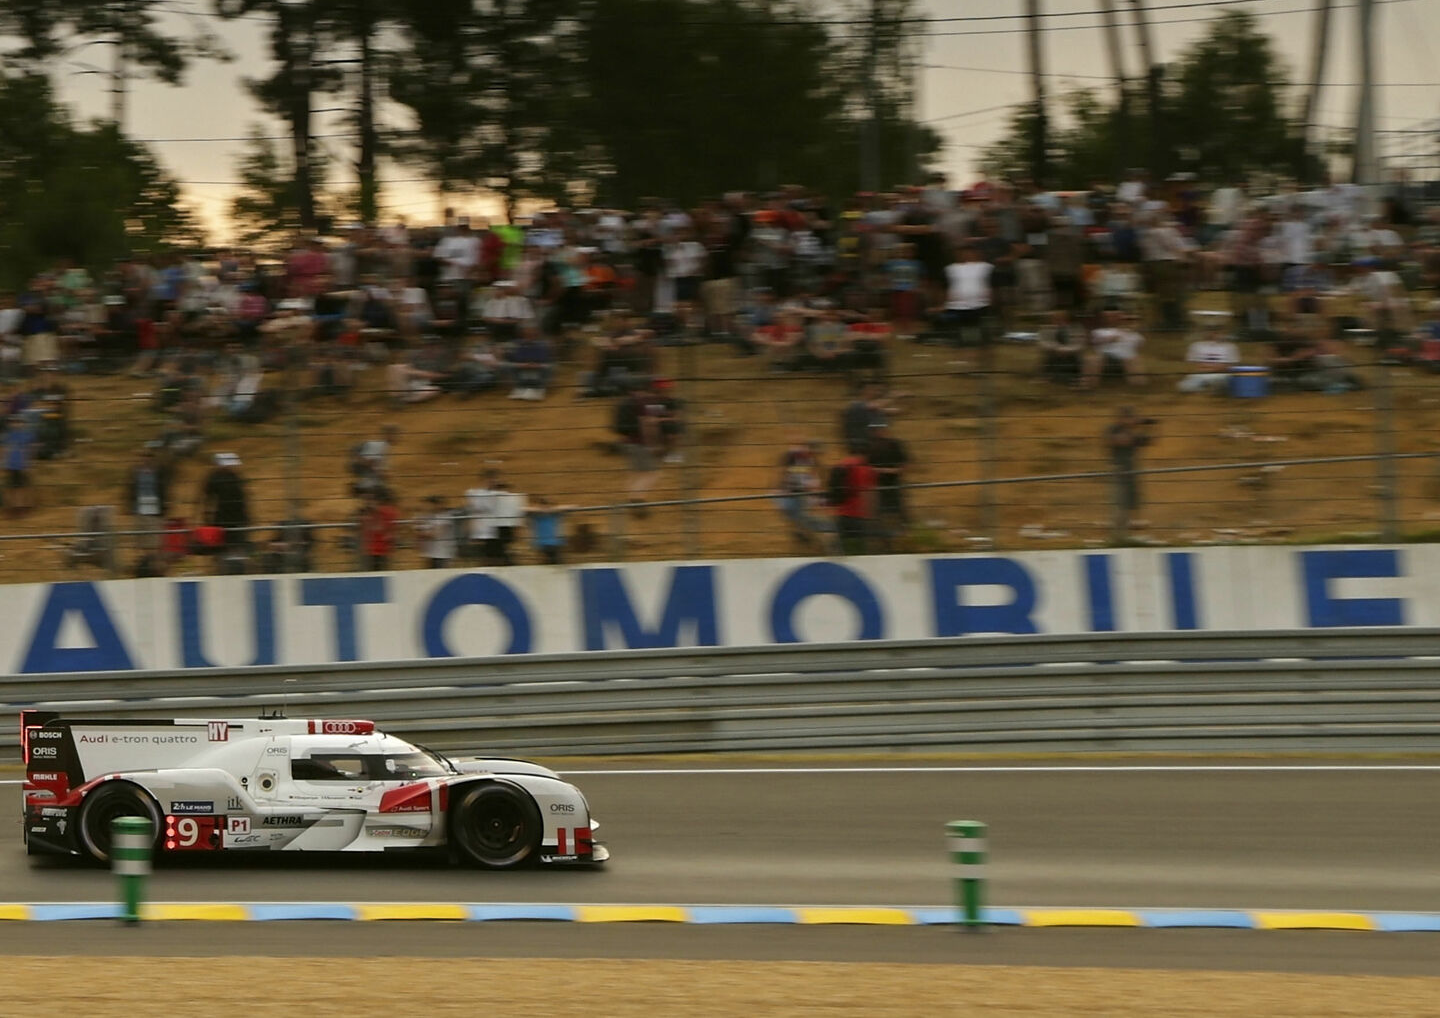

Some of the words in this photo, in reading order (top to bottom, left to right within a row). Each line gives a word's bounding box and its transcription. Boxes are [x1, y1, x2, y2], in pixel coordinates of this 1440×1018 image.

[209, 723, 227, 741] HY
[79, 734, 108, 743] Audi
[111, 735, 148, 743] e-tron
[152, 735, 197, 745] quattro
[33, 747, 57, 756] ORIS
[266, 747, 287, 755] ORIS
[550, 804, 575, 812] ORIS
[262, 816, 302, 825] AETHRA
[231, 820, 247, 832] P1
[178, 818, 199, 847] 9
